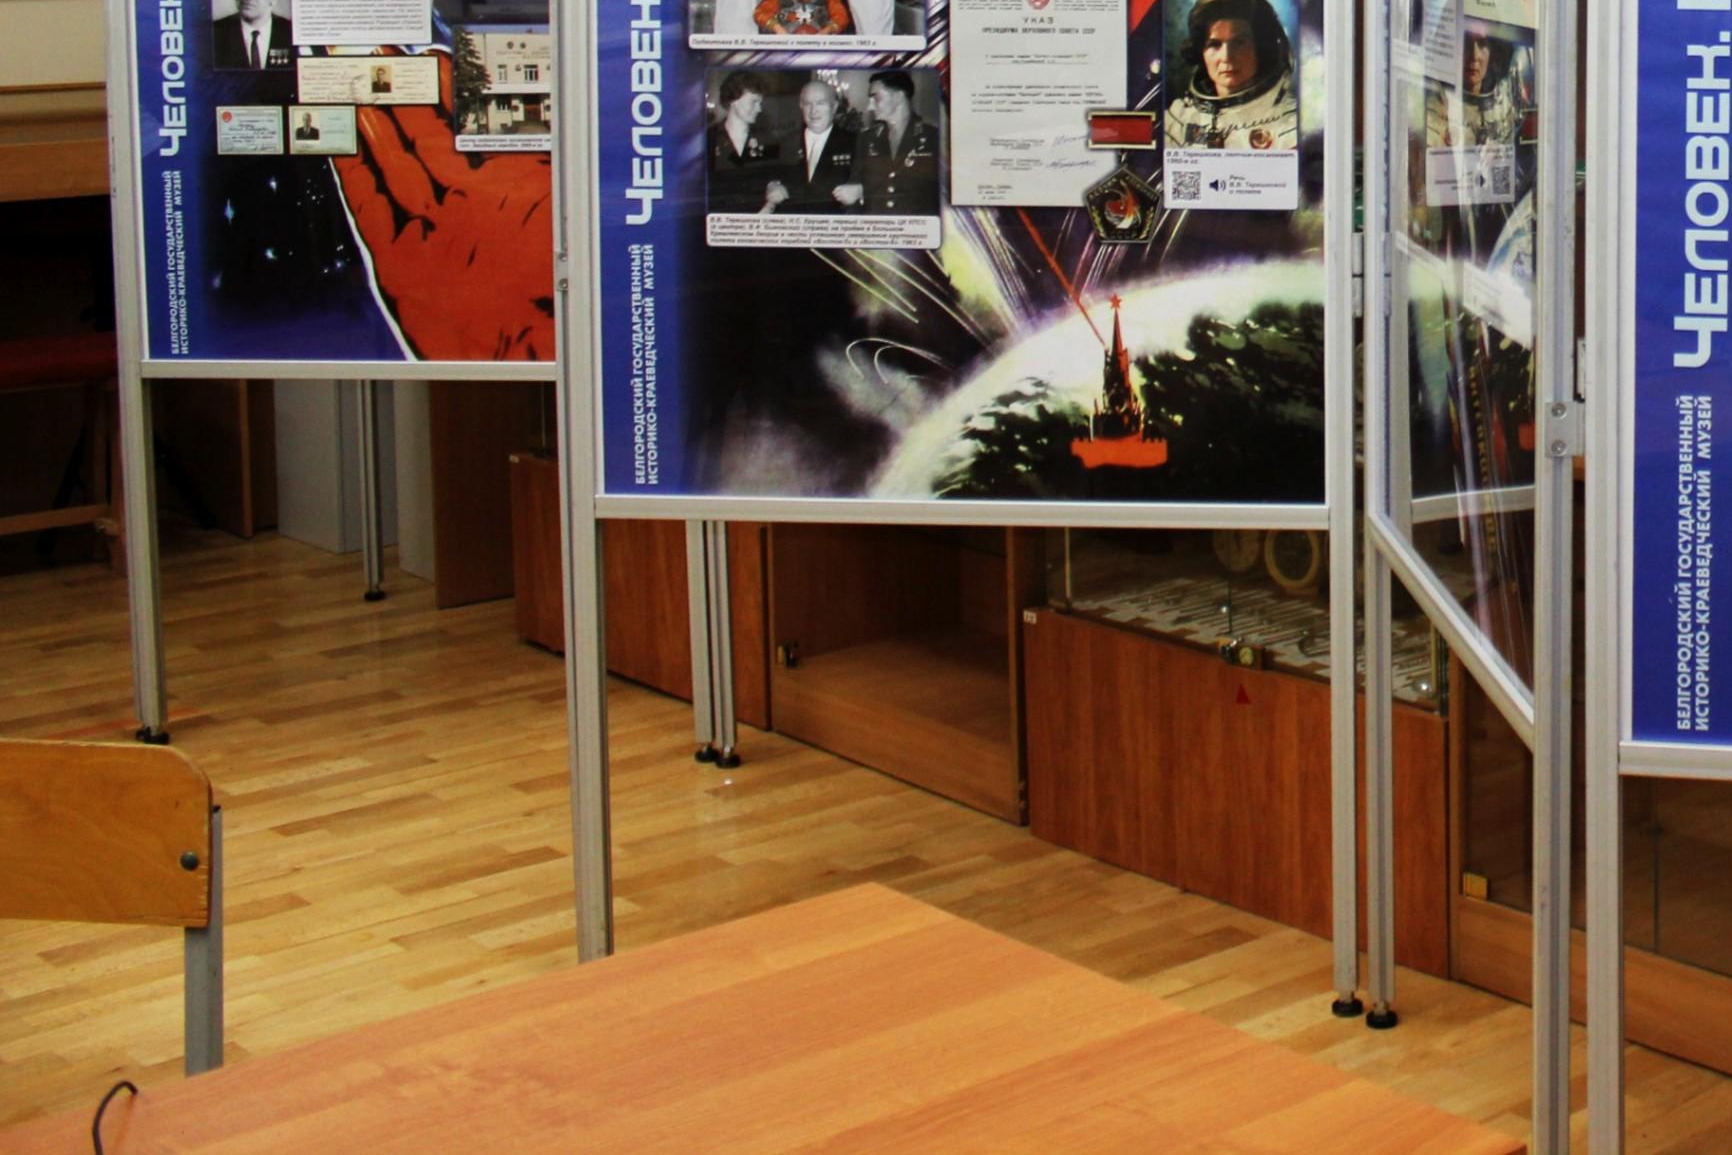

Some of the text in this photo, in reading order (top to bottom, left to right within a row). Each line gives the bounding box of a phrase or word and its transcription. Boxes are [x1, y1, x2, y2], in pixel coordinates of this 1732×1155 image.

[161, 170, 180, 354] БЕЛГОРОДСКИЙ ГОСУДАРСТВЕННЫЙ
[172, 170, 188, 354] ИСТОРИКО-КРАЕВЕДЧЕСКИЙ МУЗЕЙ
[628, 244, 646, 485] БЕЛГОРОДСКИЙ ГОСУДАРСТВЕННЫЙ
[641, 244, 658, 485] ИСТОРИКО-КРАЕВЕДЧЕСКИЙ МУЗЕЙ
[1674, 395, 1694, 731] БЕЛГОРОДСКИЙ ГОСУДАРСТВЕННЫЙ
[1693, 395, 1712, 731] ИСТОРИКО-КРАЕВЕДЧЕСКИЙ МУЗЕЙ
